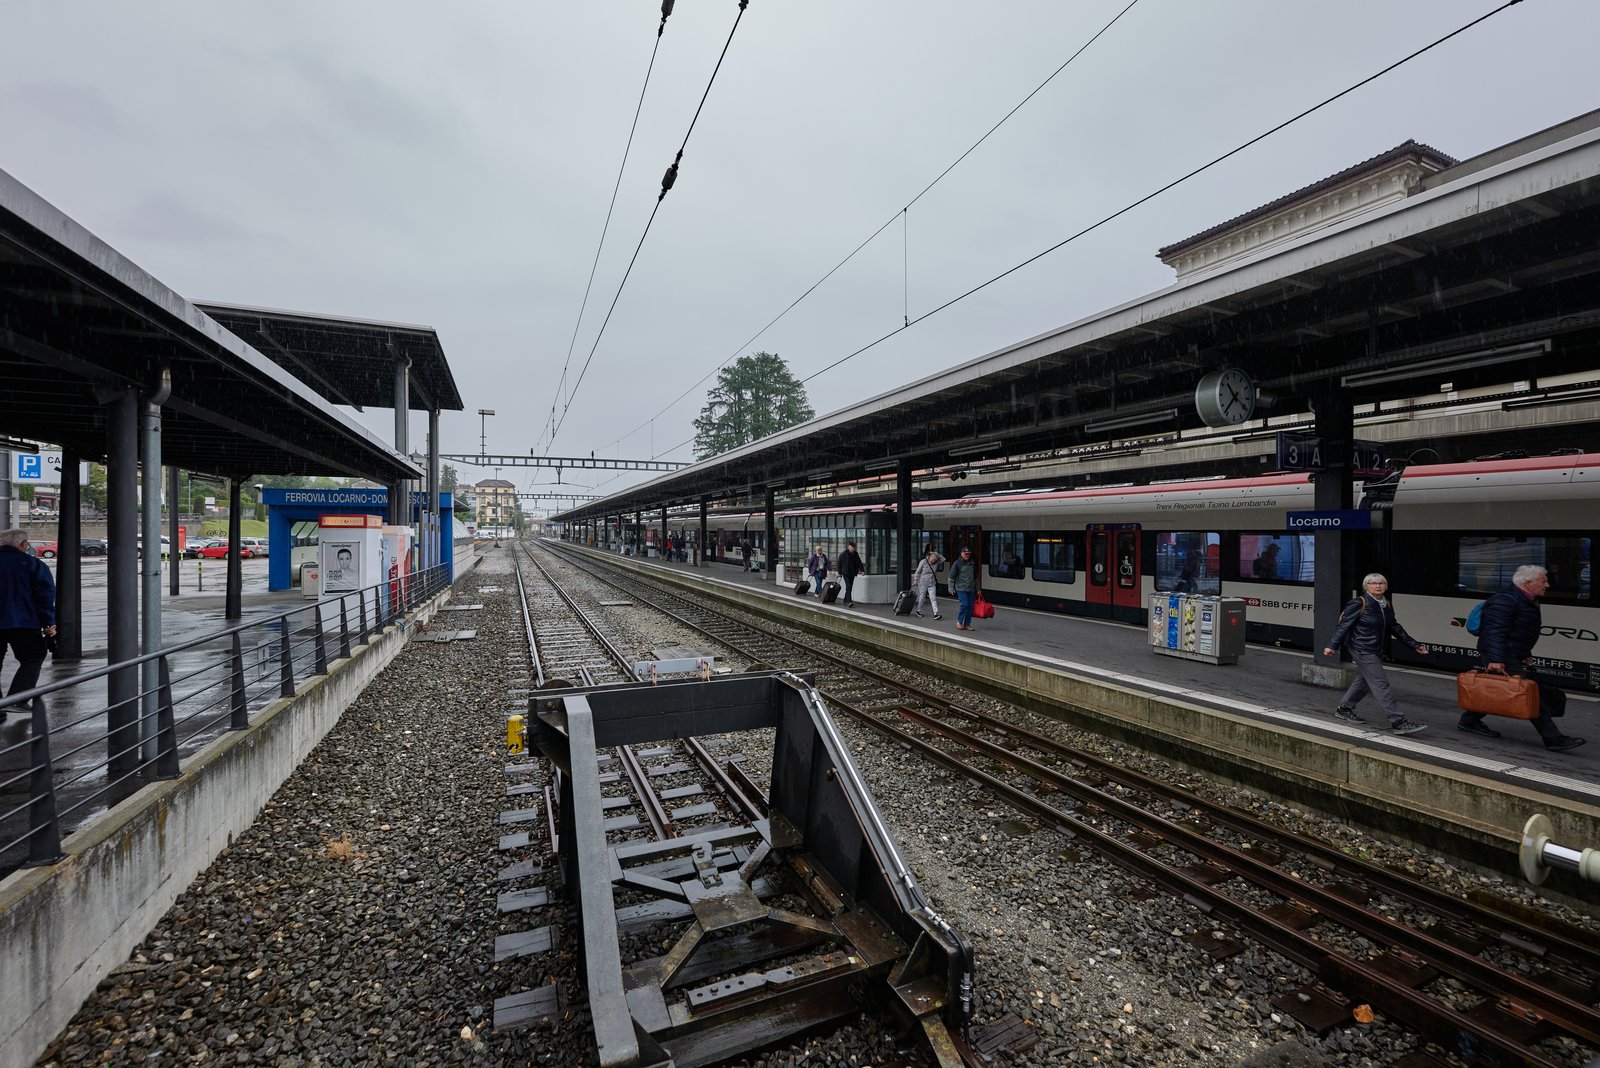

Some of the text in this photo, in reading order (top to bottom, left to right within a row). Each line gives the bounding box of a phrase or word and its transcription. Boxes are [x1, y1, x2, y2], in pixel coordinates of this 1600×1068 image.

[1288, 445, 1321, 466] 3 A
[23, 456, 37, 471] P
[1372, 453, 1380, 471] 2
[285, 492, 326, 503] FERROVIA
[1173, 502, 1205, 510] Regionali
[1231, 500, 1277, 508] Lombardia
[1289, 516, 1341, 527] Locarno
[1261, 599, 1314, 612] SBB CFF FF
[1432, 645, 1443, 653] 94
[1445, 646, 1457, 654] 85
[1467, 649, 1481, 657] 52
